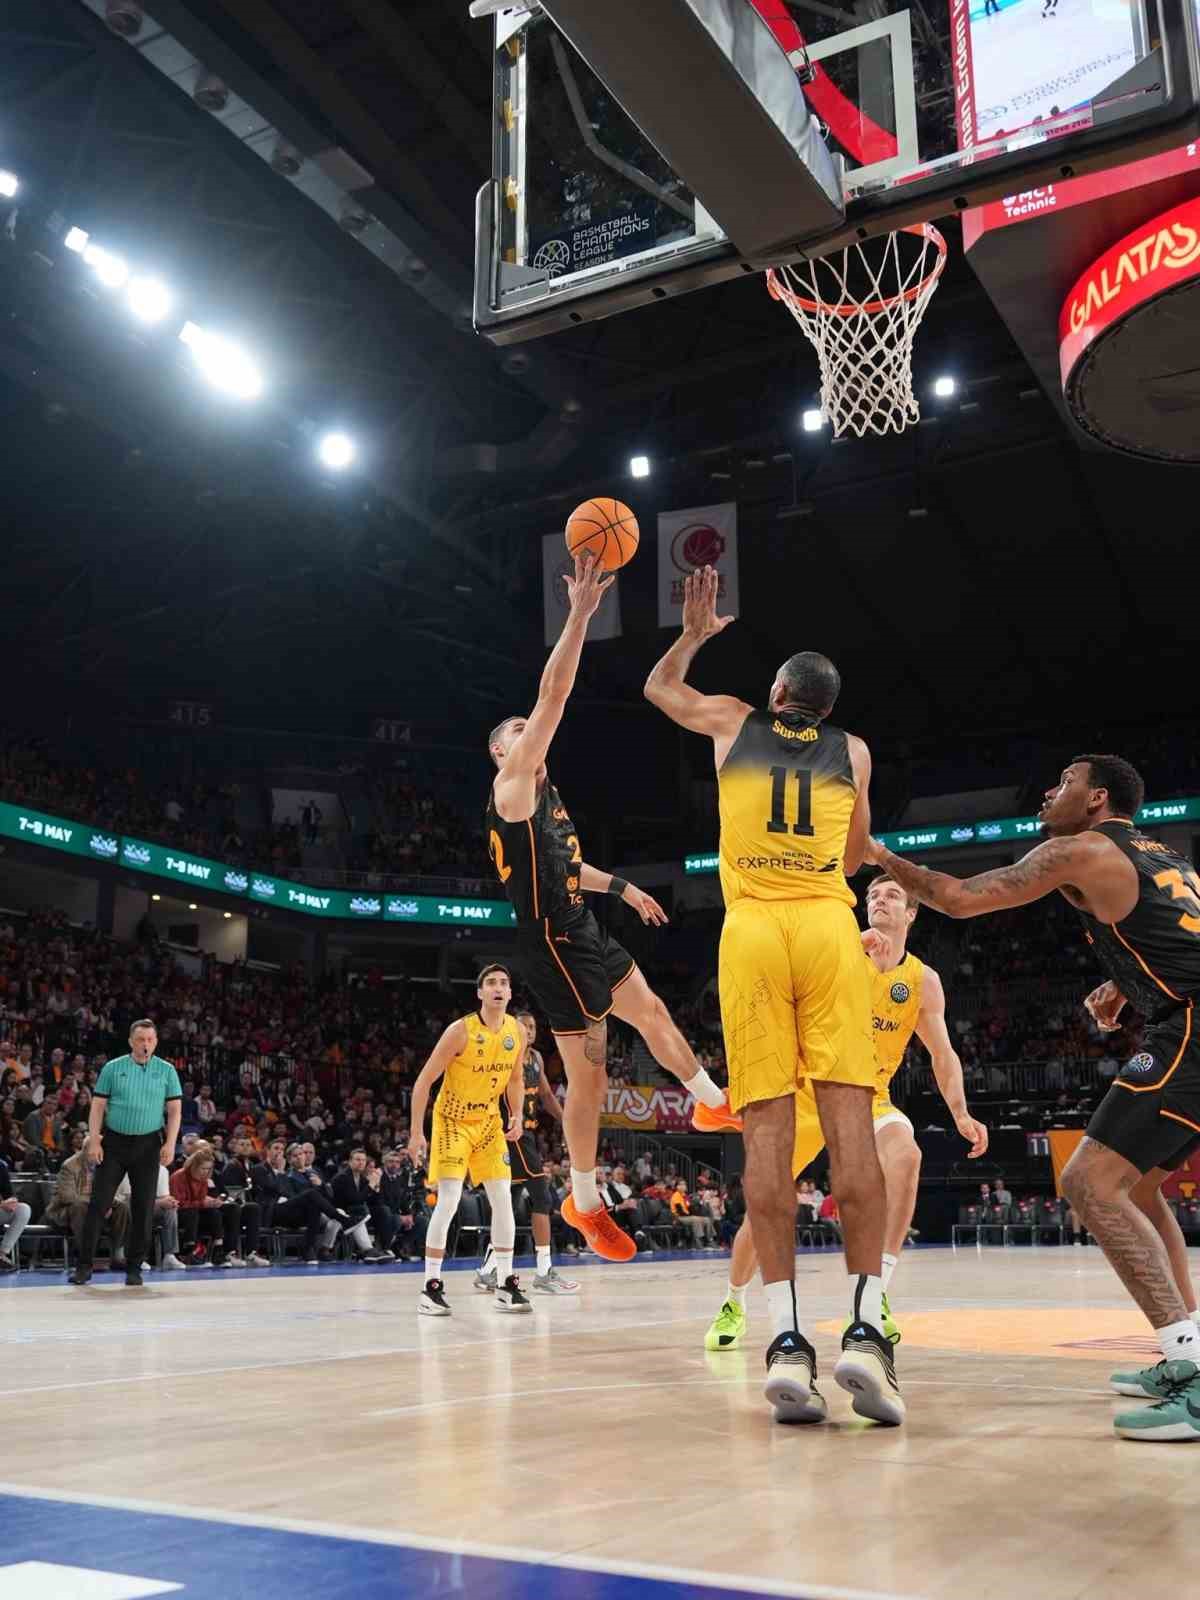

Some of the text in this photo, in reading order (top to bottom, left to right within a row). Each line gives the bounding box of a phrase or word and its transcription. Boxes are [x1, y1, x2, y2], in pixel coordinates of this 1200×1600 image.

[955, 14, 970, 100] Erdem
[1004, 196, 1057, 218] Technic
[572, 218, 650, 251] CHAMPIONS
[573, 212, 641, 241] BASKETBALL
[572, 240, 614, 261] LEAGUE
[573, 256, 605, 270] SEASON
[767, 766, 815, 837] 11
[1163, 804, 1187, 816] MAY
[44, 823, 73, 843] MAY
[917, 833, 938, 844] MAY
[187, 862, 211, 880] MAY
[736, 857, 816, 872] EXPRESS
[306, 894, 331, 909] MAY
[463, 906, 492, 919] MAY
[472, 1063, 484, 1073] LA
[1030, 1138, 1049, 1156] 11
